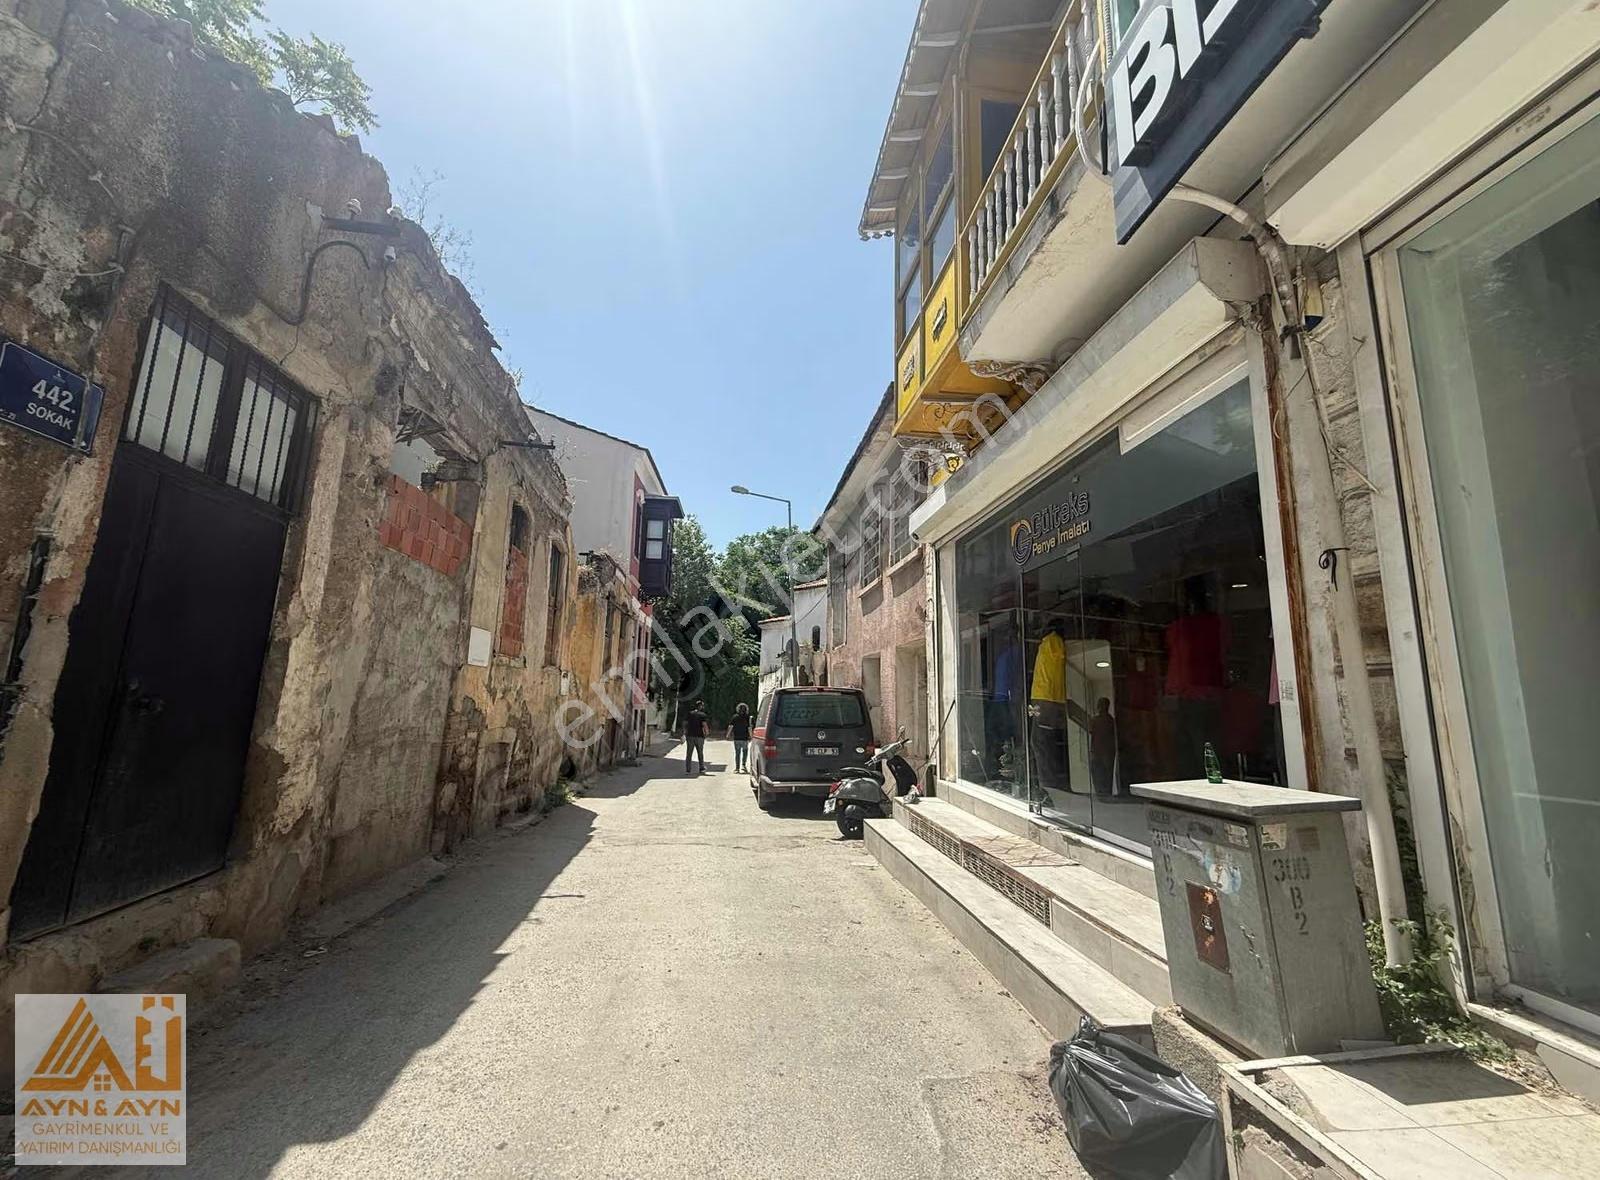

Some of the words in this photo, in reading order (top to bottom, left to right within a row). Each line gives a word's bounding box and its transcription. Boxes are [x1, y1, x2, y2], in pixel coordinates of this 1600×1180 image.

[32, 379, 76, 414] 442.
[26, 402, 73, 430] SOKAK
[1031, 491, 1089, 539] Gülteks
[1295, 911, 1310, 936] 2
